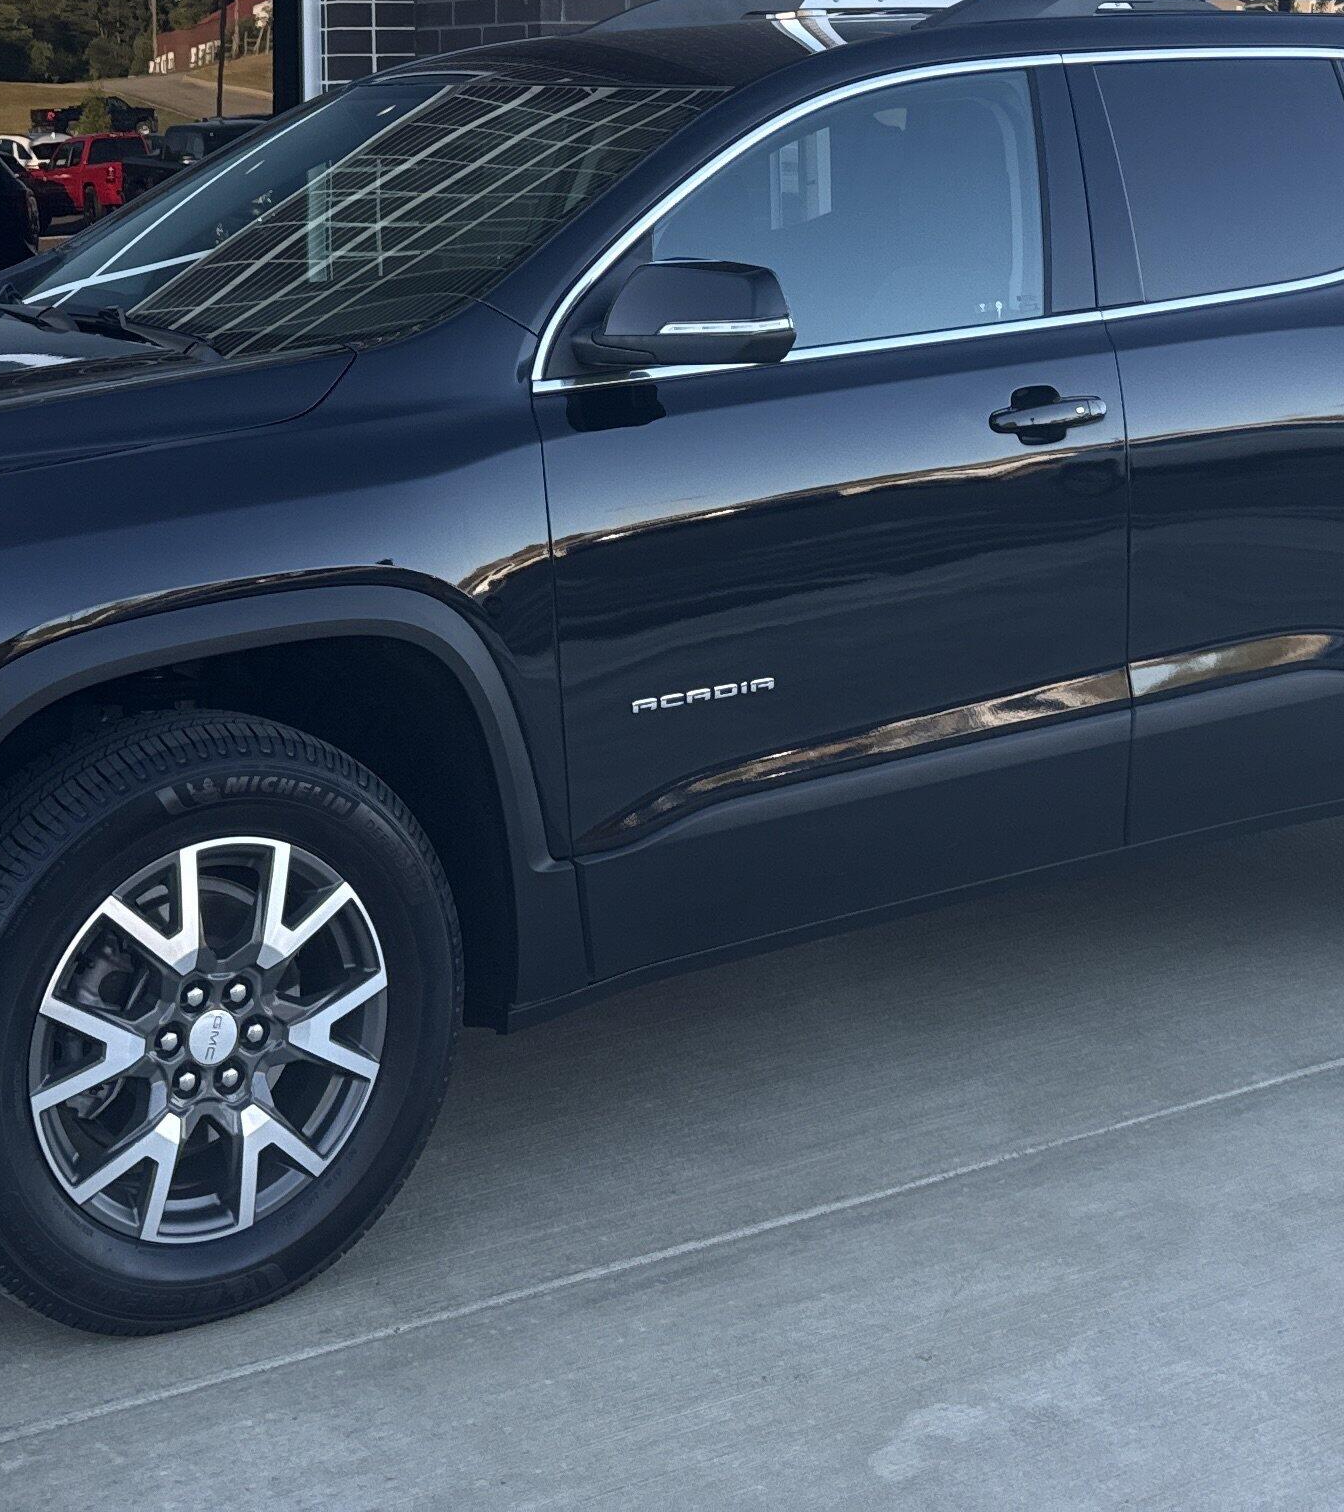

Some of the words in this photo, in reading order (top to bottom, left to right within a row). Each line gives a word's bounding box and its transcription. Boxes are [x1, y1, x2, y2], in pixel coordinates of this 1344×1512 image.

[631, 677, 776, 714] ACADIA
[225, 775, 353, 817] MICHELIN
[204, 1015, 223, 1061] GMC
